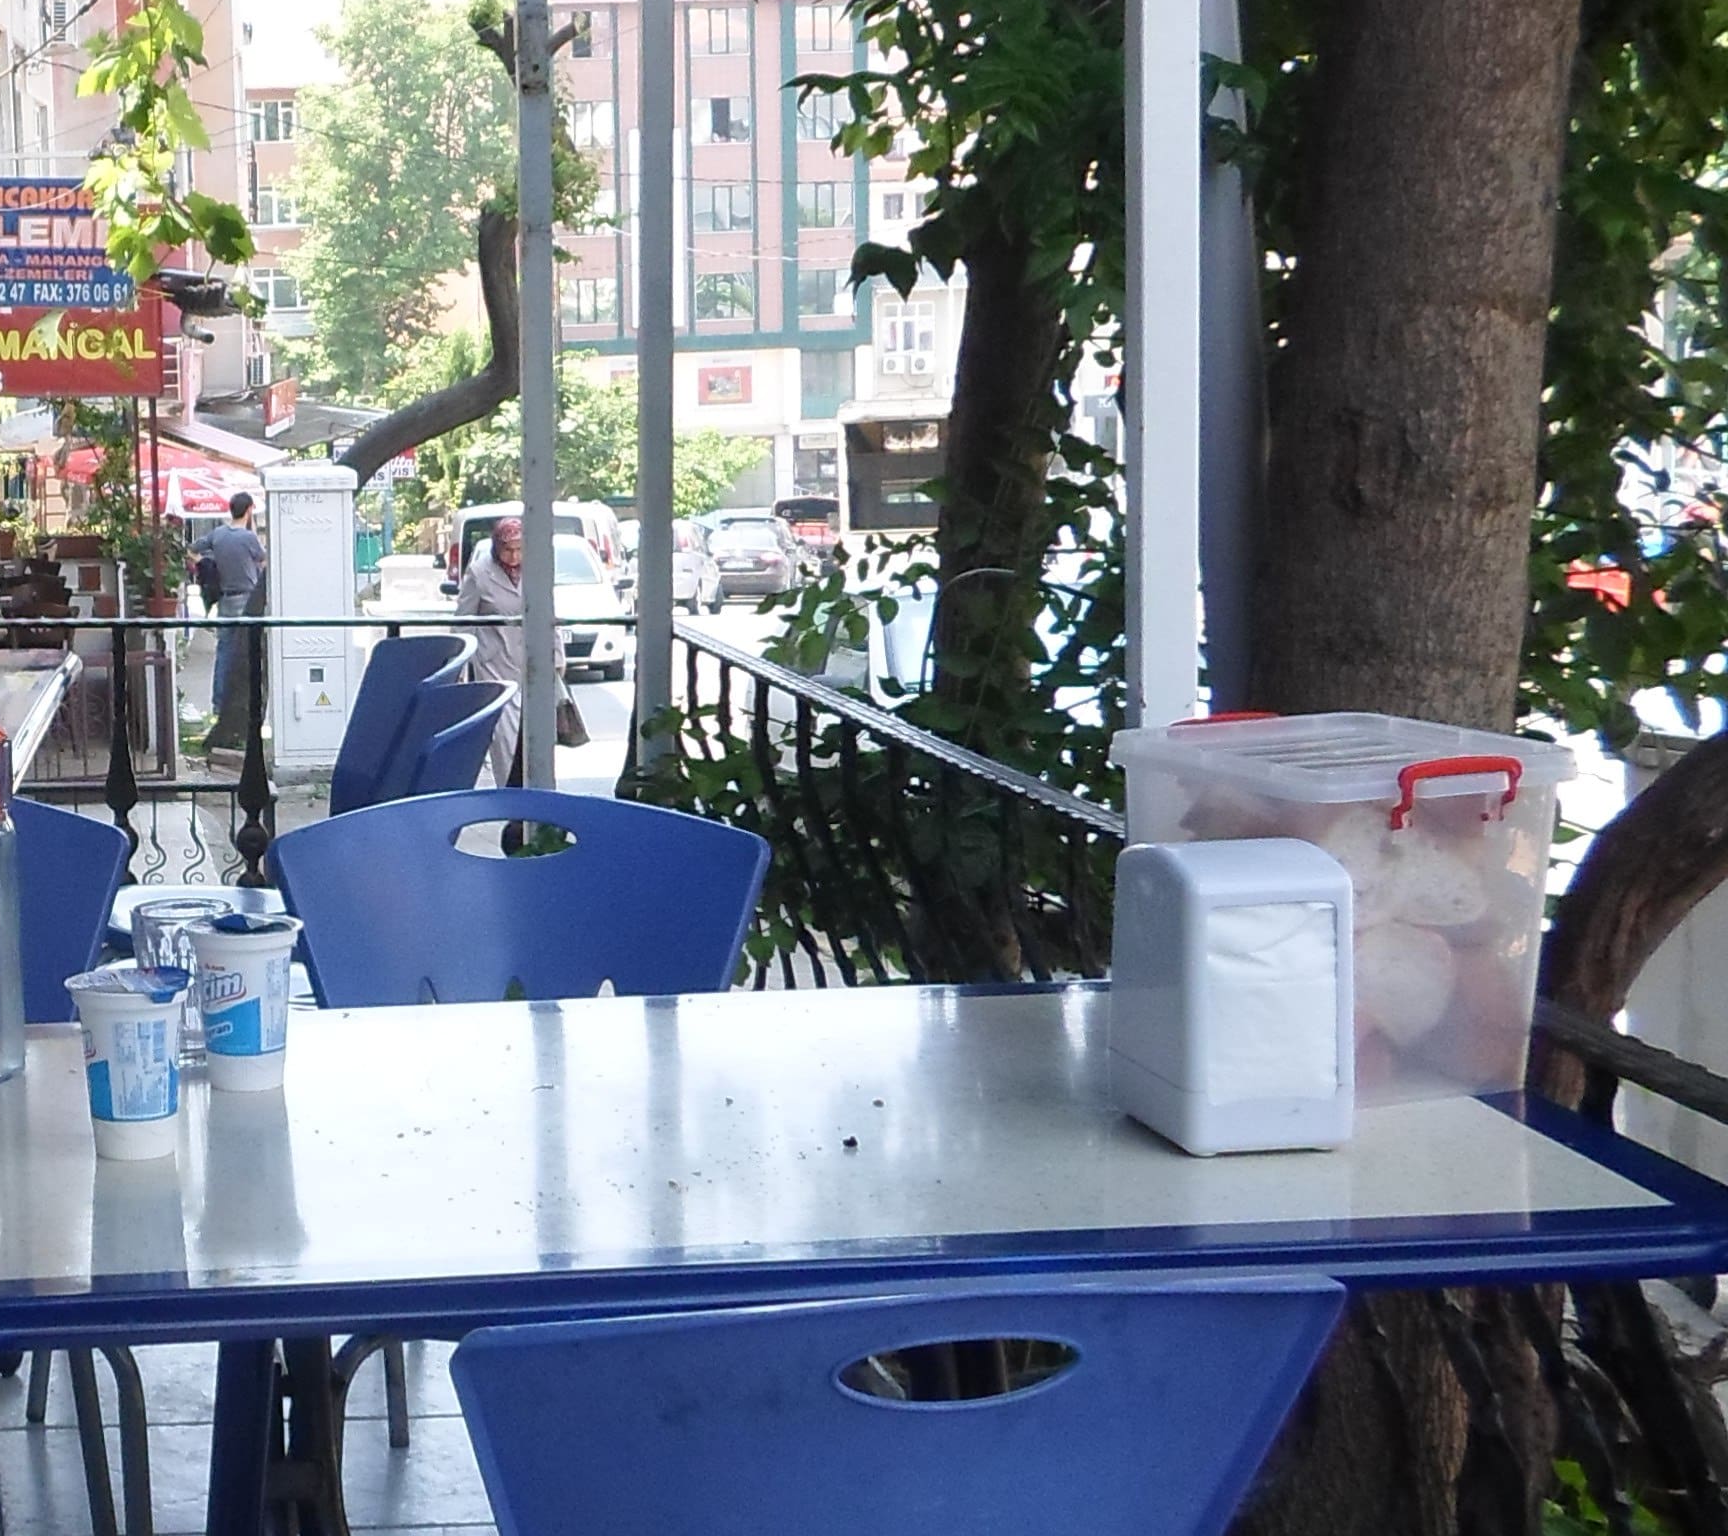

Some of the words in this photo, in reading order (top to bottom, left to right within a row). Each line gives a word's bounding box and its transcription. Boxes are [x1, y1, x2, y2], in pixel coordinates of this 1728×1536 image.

[10, 282, 26, 301] 47
[33, 283, 64, 302] FAX:
[66, 283, 90, 302] 376
[93, 283, 110, 302] 06
